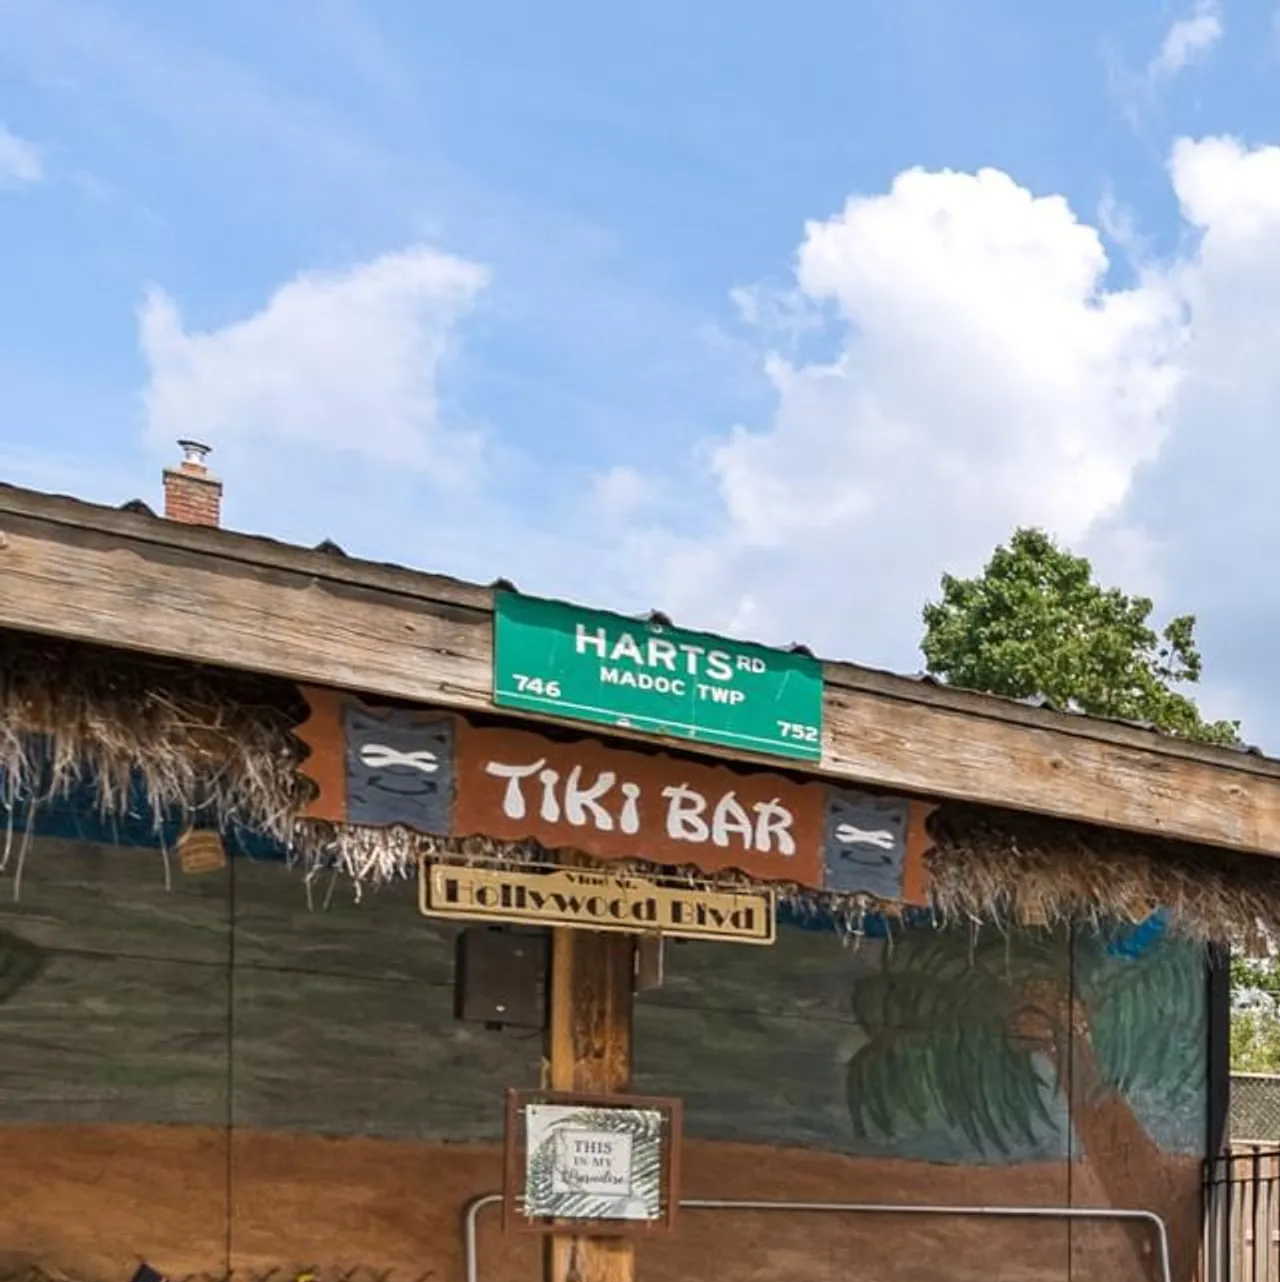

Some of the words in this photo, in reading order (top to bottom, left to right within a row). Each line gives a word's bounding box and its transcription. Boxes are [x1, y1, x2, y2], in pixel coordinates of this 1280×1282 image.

[575, 622, 735, 682] HARTS
[736, 654, 766, 674] RD
[512, 673, 562, 699] 746
[600, 666, 687, 696] MADOC
[697, 683, 746, 706] TWP
[776, 720, 819, 743] 752
[660, 782, 797, 856] BAR
[444, 877, 658, 922] Hollywood
[670, 900, 755, 931] Blvd
[574, 1140, 613, 1155] THIS
